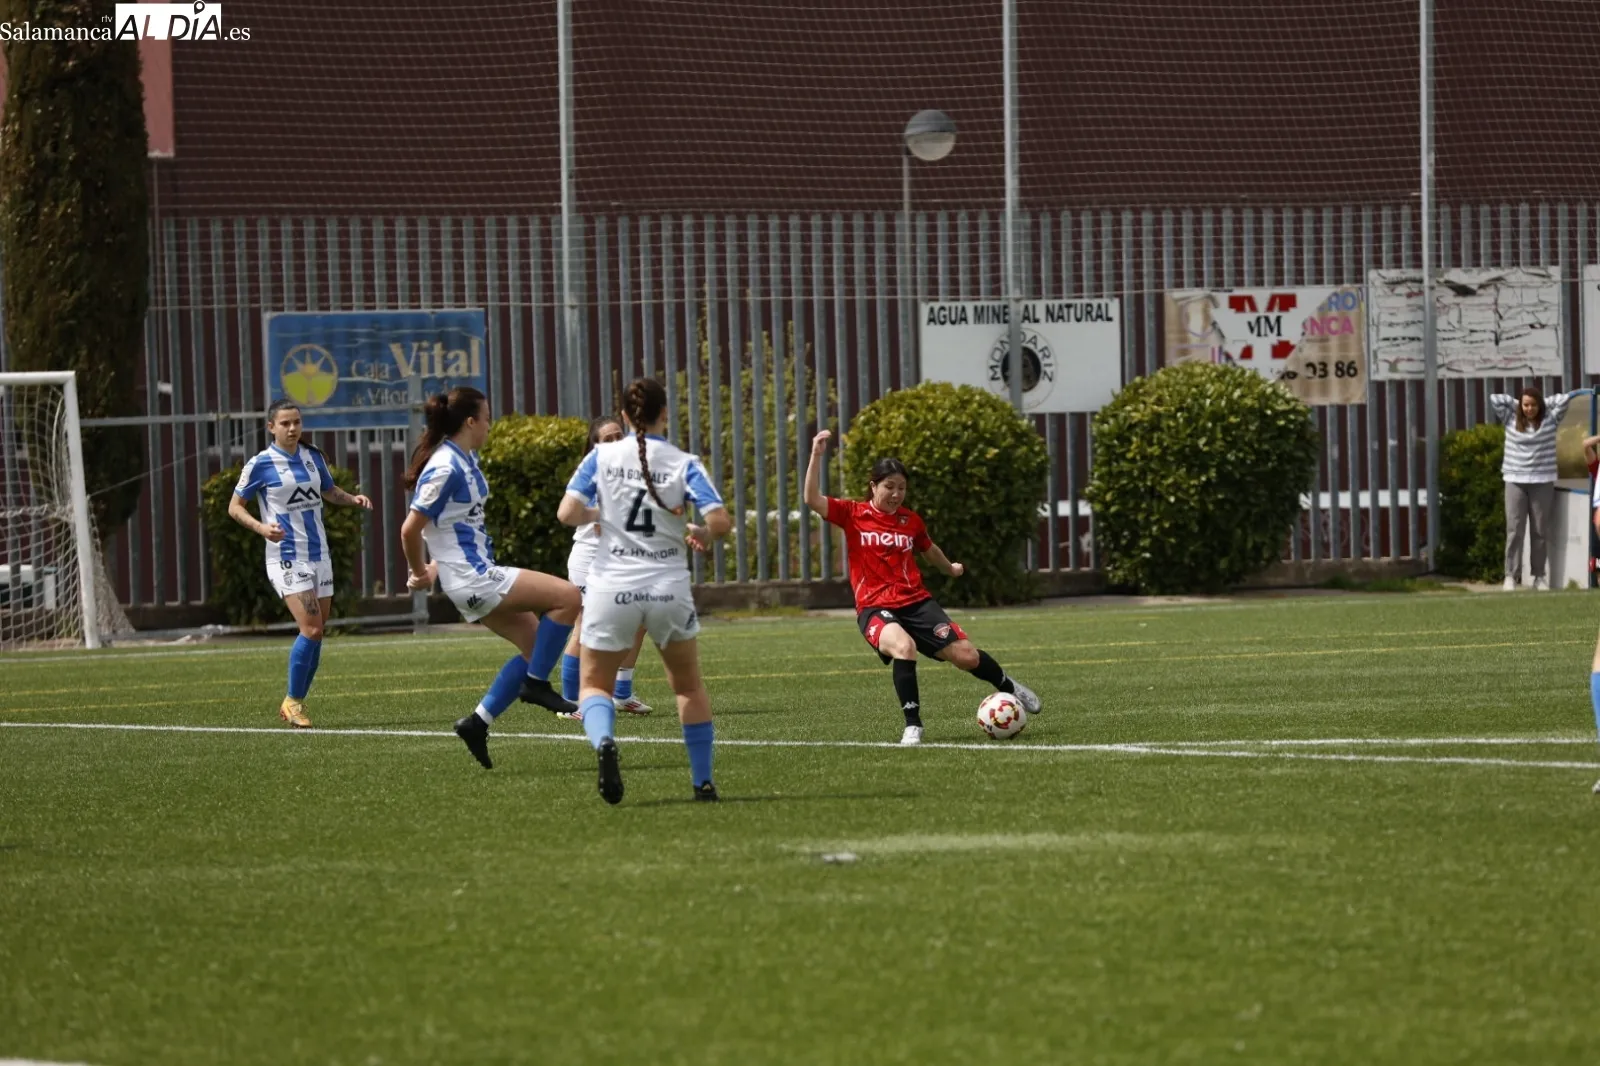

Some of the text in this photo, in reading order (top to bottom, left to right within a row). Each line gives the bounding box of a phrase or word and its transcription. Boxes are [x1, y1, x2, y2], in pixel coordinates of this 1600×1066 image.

[1320, 291, 1357, 312] RO
[926, 302, 1113, 326] AGUA MINEAL NATURAL
[389, 336, 481, 378] Vital
[1335, 360, 1358, 379] 86
[625, 489, 656, 533] 4
